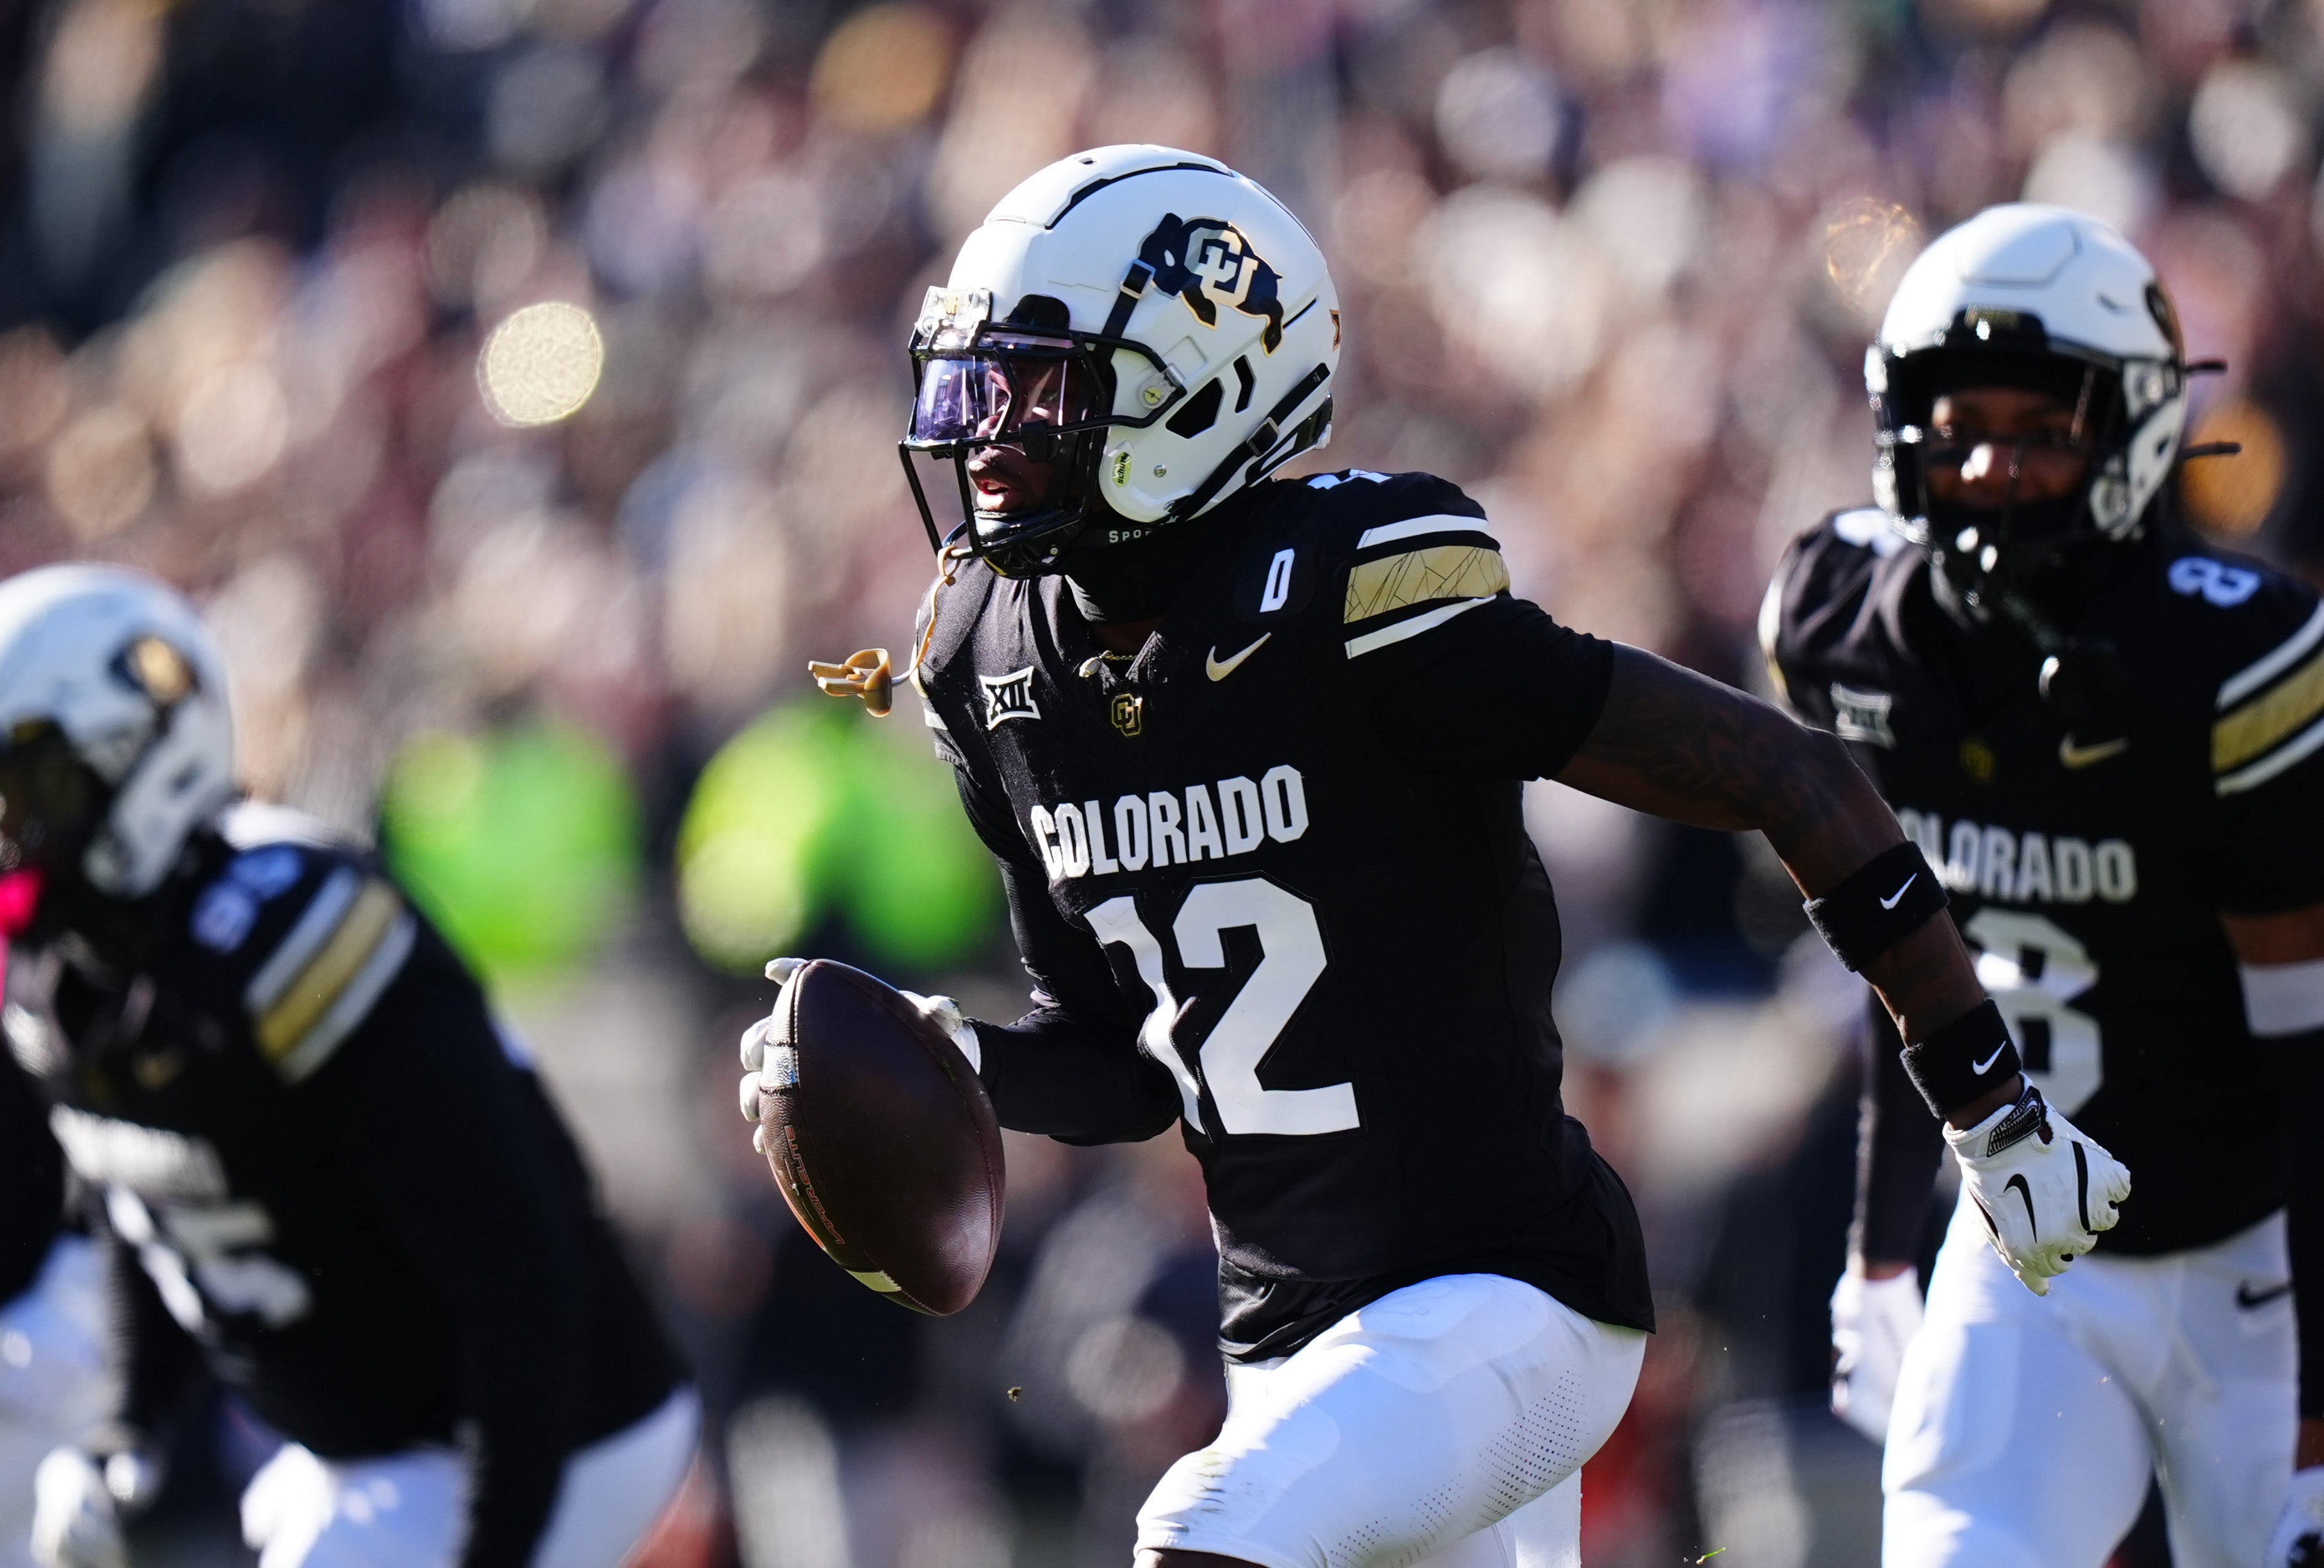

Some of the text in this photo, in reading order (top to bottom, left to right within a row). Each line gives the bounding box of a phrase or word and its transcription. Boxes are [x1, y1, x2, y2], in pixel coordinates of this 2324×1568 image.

[1183, 227, 1259, 308] CU
[2168, 556, 2261, 608] 8
[1030, 764, 1310, 880] COLORADO
[1894, 807, 2138, 904] OLORADO
[1083, 877, 1360, 1135] 12
[1965, 907, 2105, 1118] 8
[784, 1125, 811, 1185] ELITE
